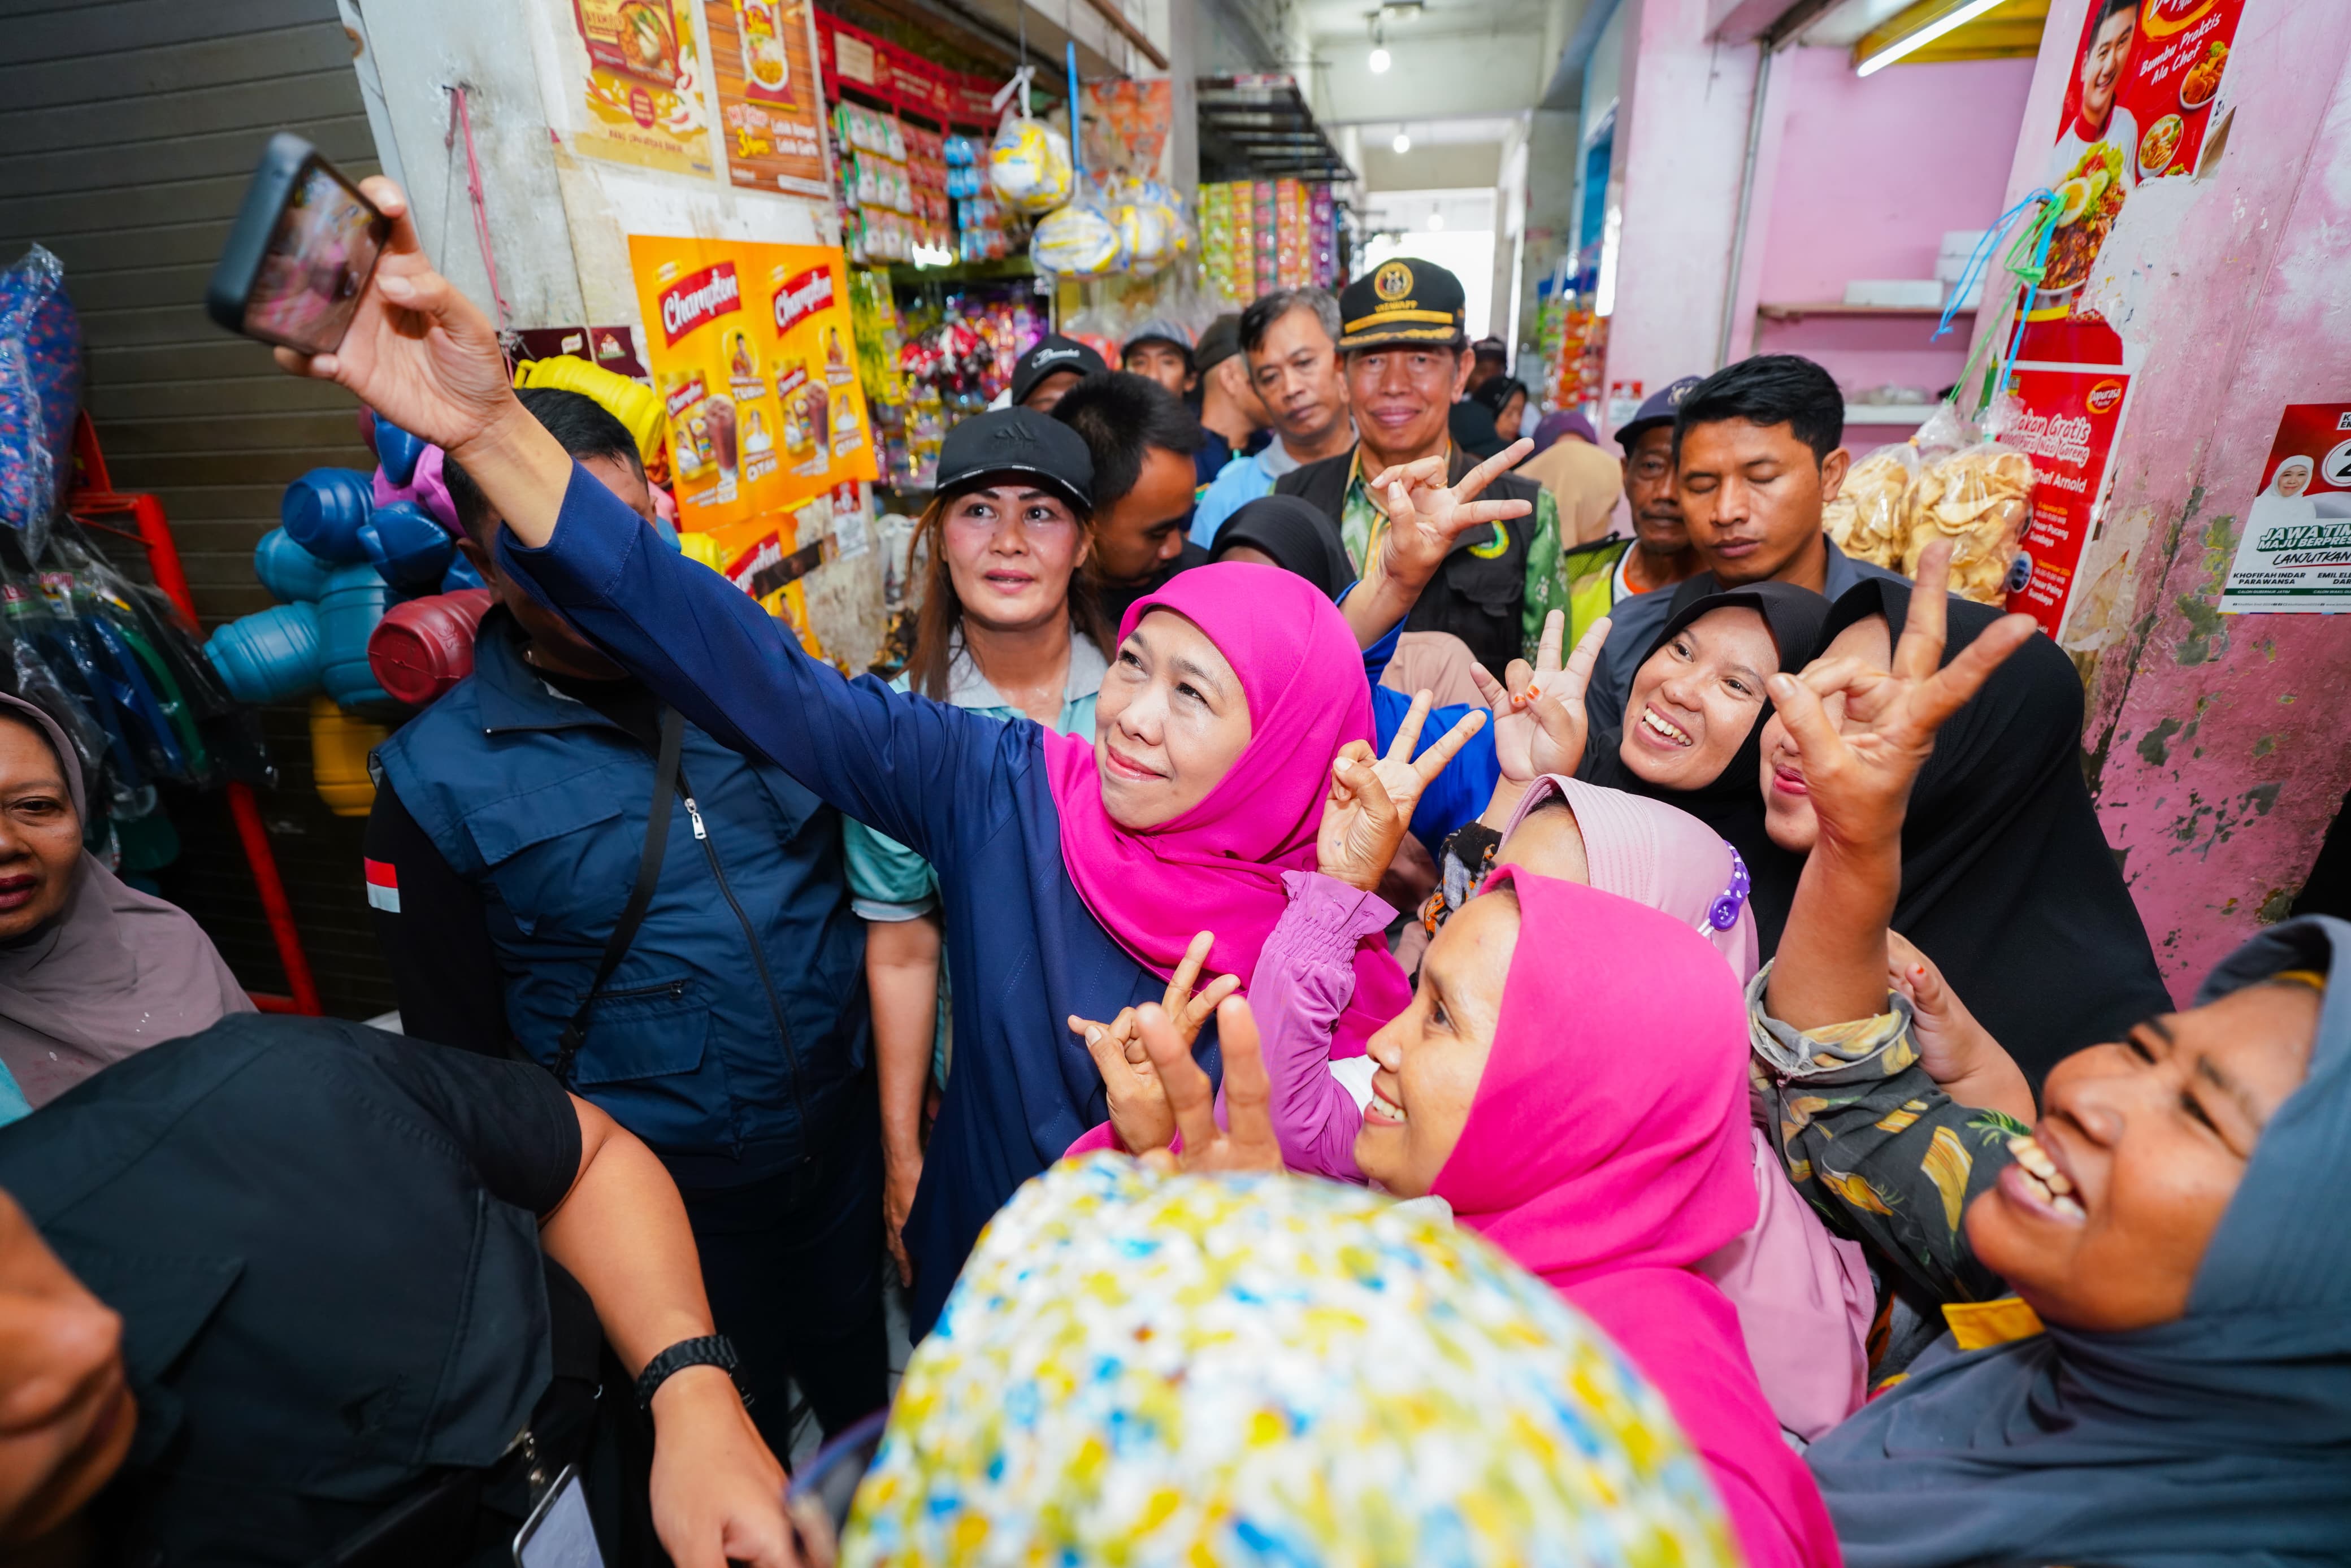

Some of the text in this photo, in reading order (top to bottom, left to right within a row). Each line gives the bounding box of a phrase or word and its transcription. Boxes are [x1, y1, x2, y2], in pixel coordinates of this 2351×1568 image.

[2139, 13, 2222, 77] Bumbu Praktis
[2151, 40, 2202, 86] Ala Chef
[663, 268, 739, 334] Champion
[775, 270, 832, 328] Champion
[2088, 388, 2121, 405] Dapurasa
[2016, 408, 2091, 445] akan Gratis
[2057, 442, 2090, 468] Goreng
[2053, 474, 2088, 493] Arnold
[2258, 538, 2297, 550] MAJU
[2261, 525, 2320, 541] JAWA
